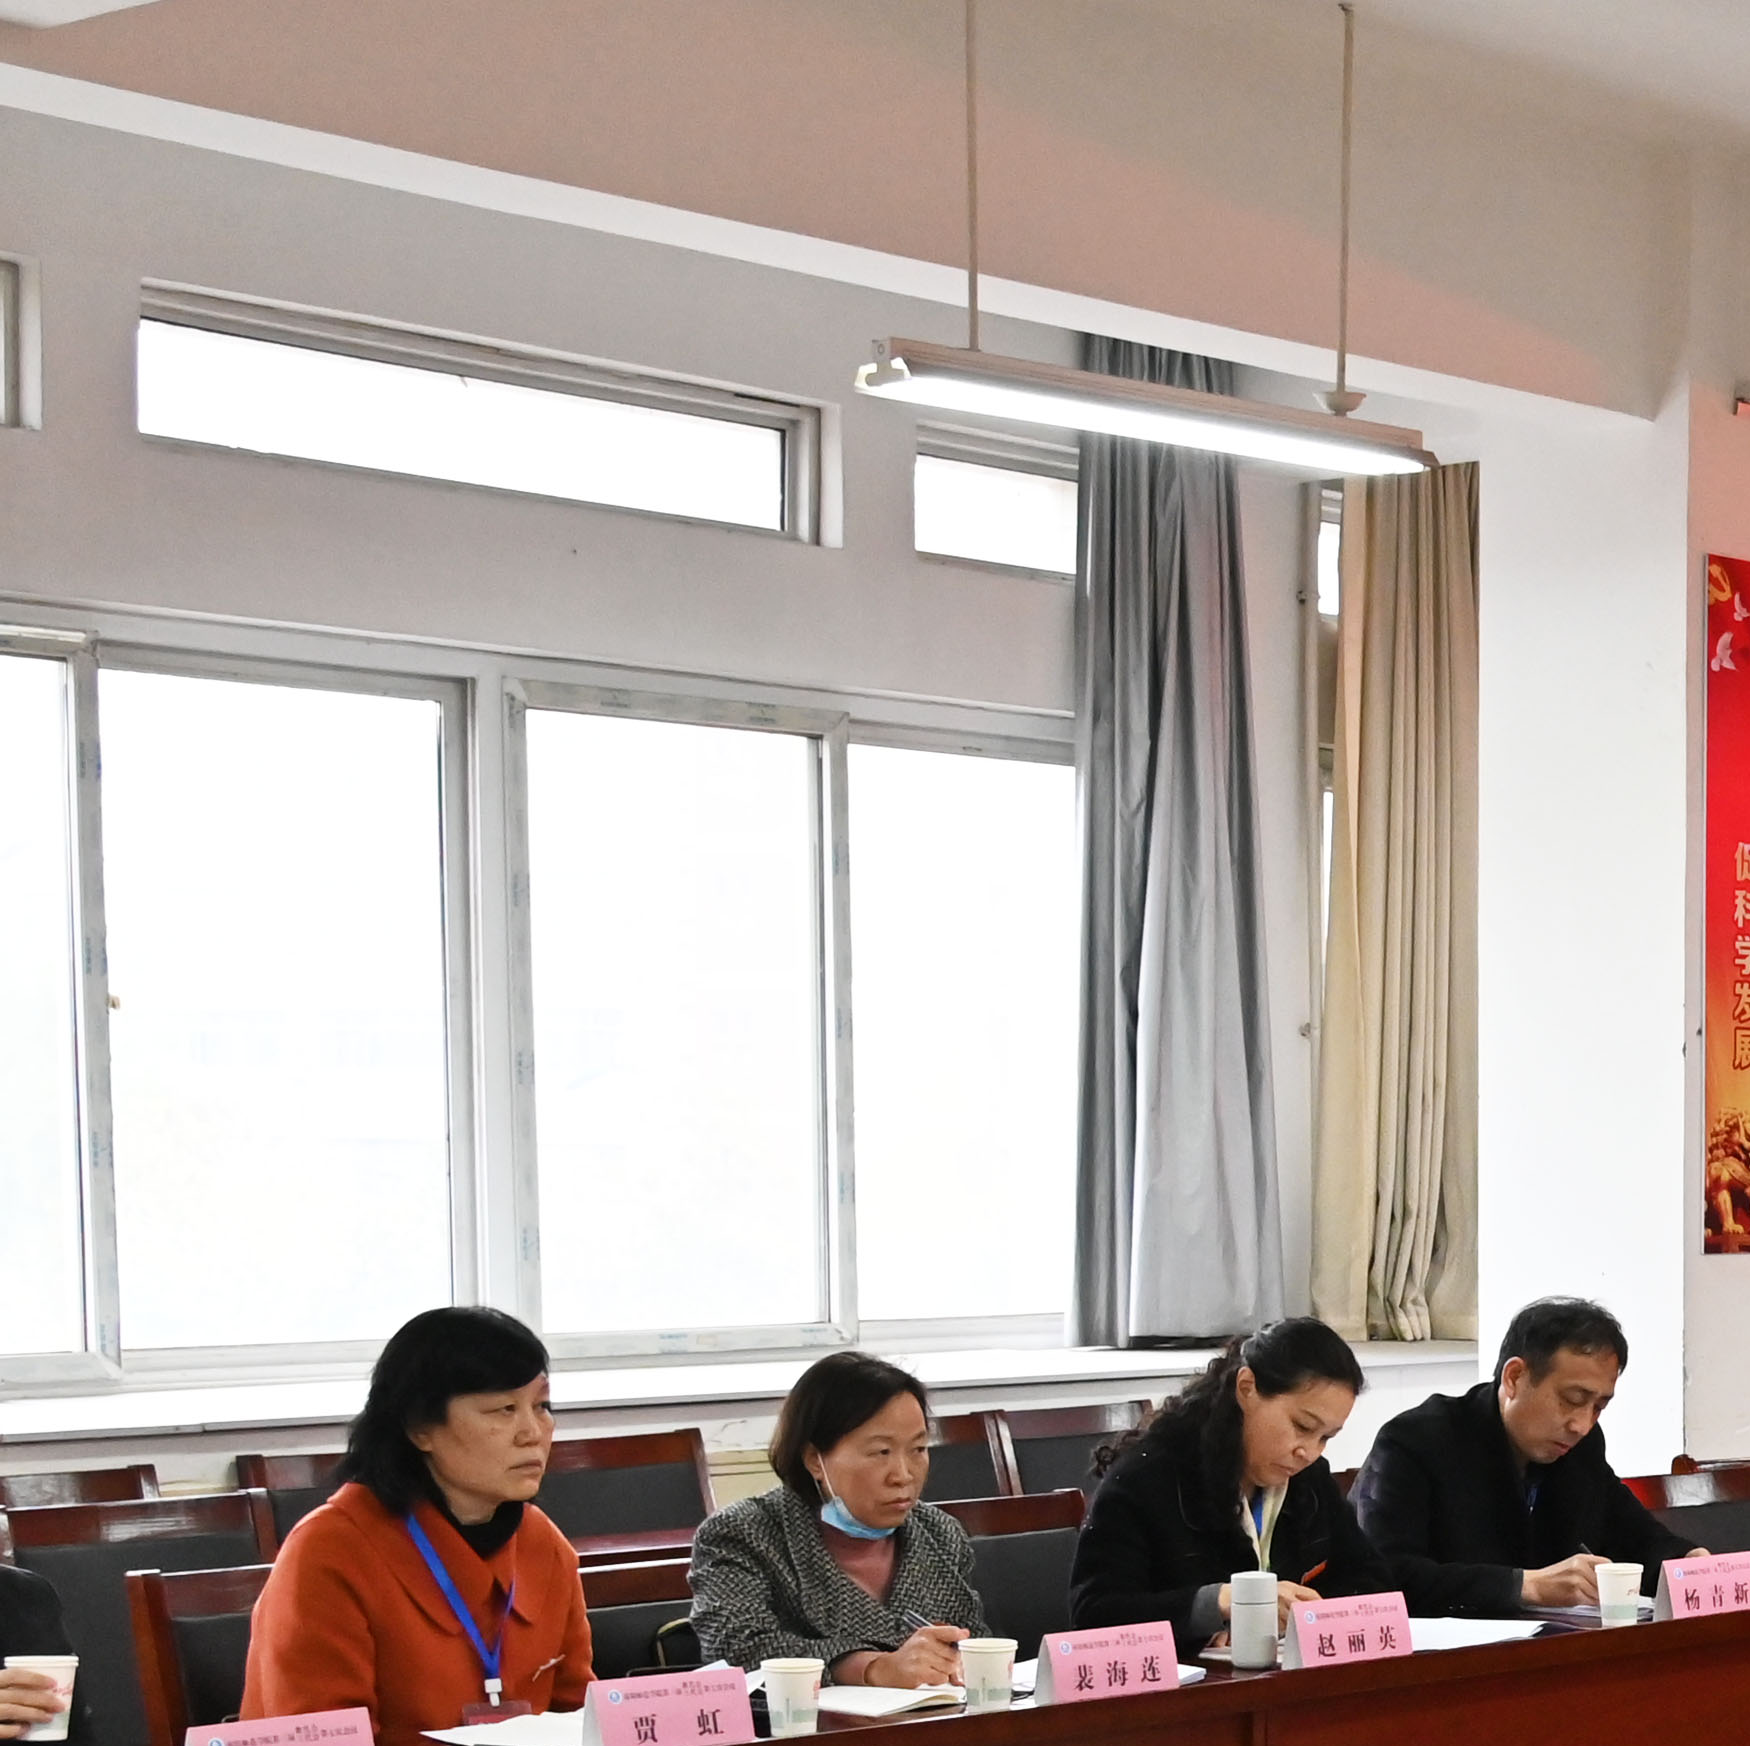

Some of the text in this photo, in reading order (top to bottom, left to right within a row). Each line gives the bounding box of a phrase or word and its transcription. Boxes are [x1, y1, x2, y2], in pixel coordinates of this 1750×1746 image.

[1317, 1625, 1397, 1658] 赵丽英
[632, 1708, 725, 1745] 贾虹
